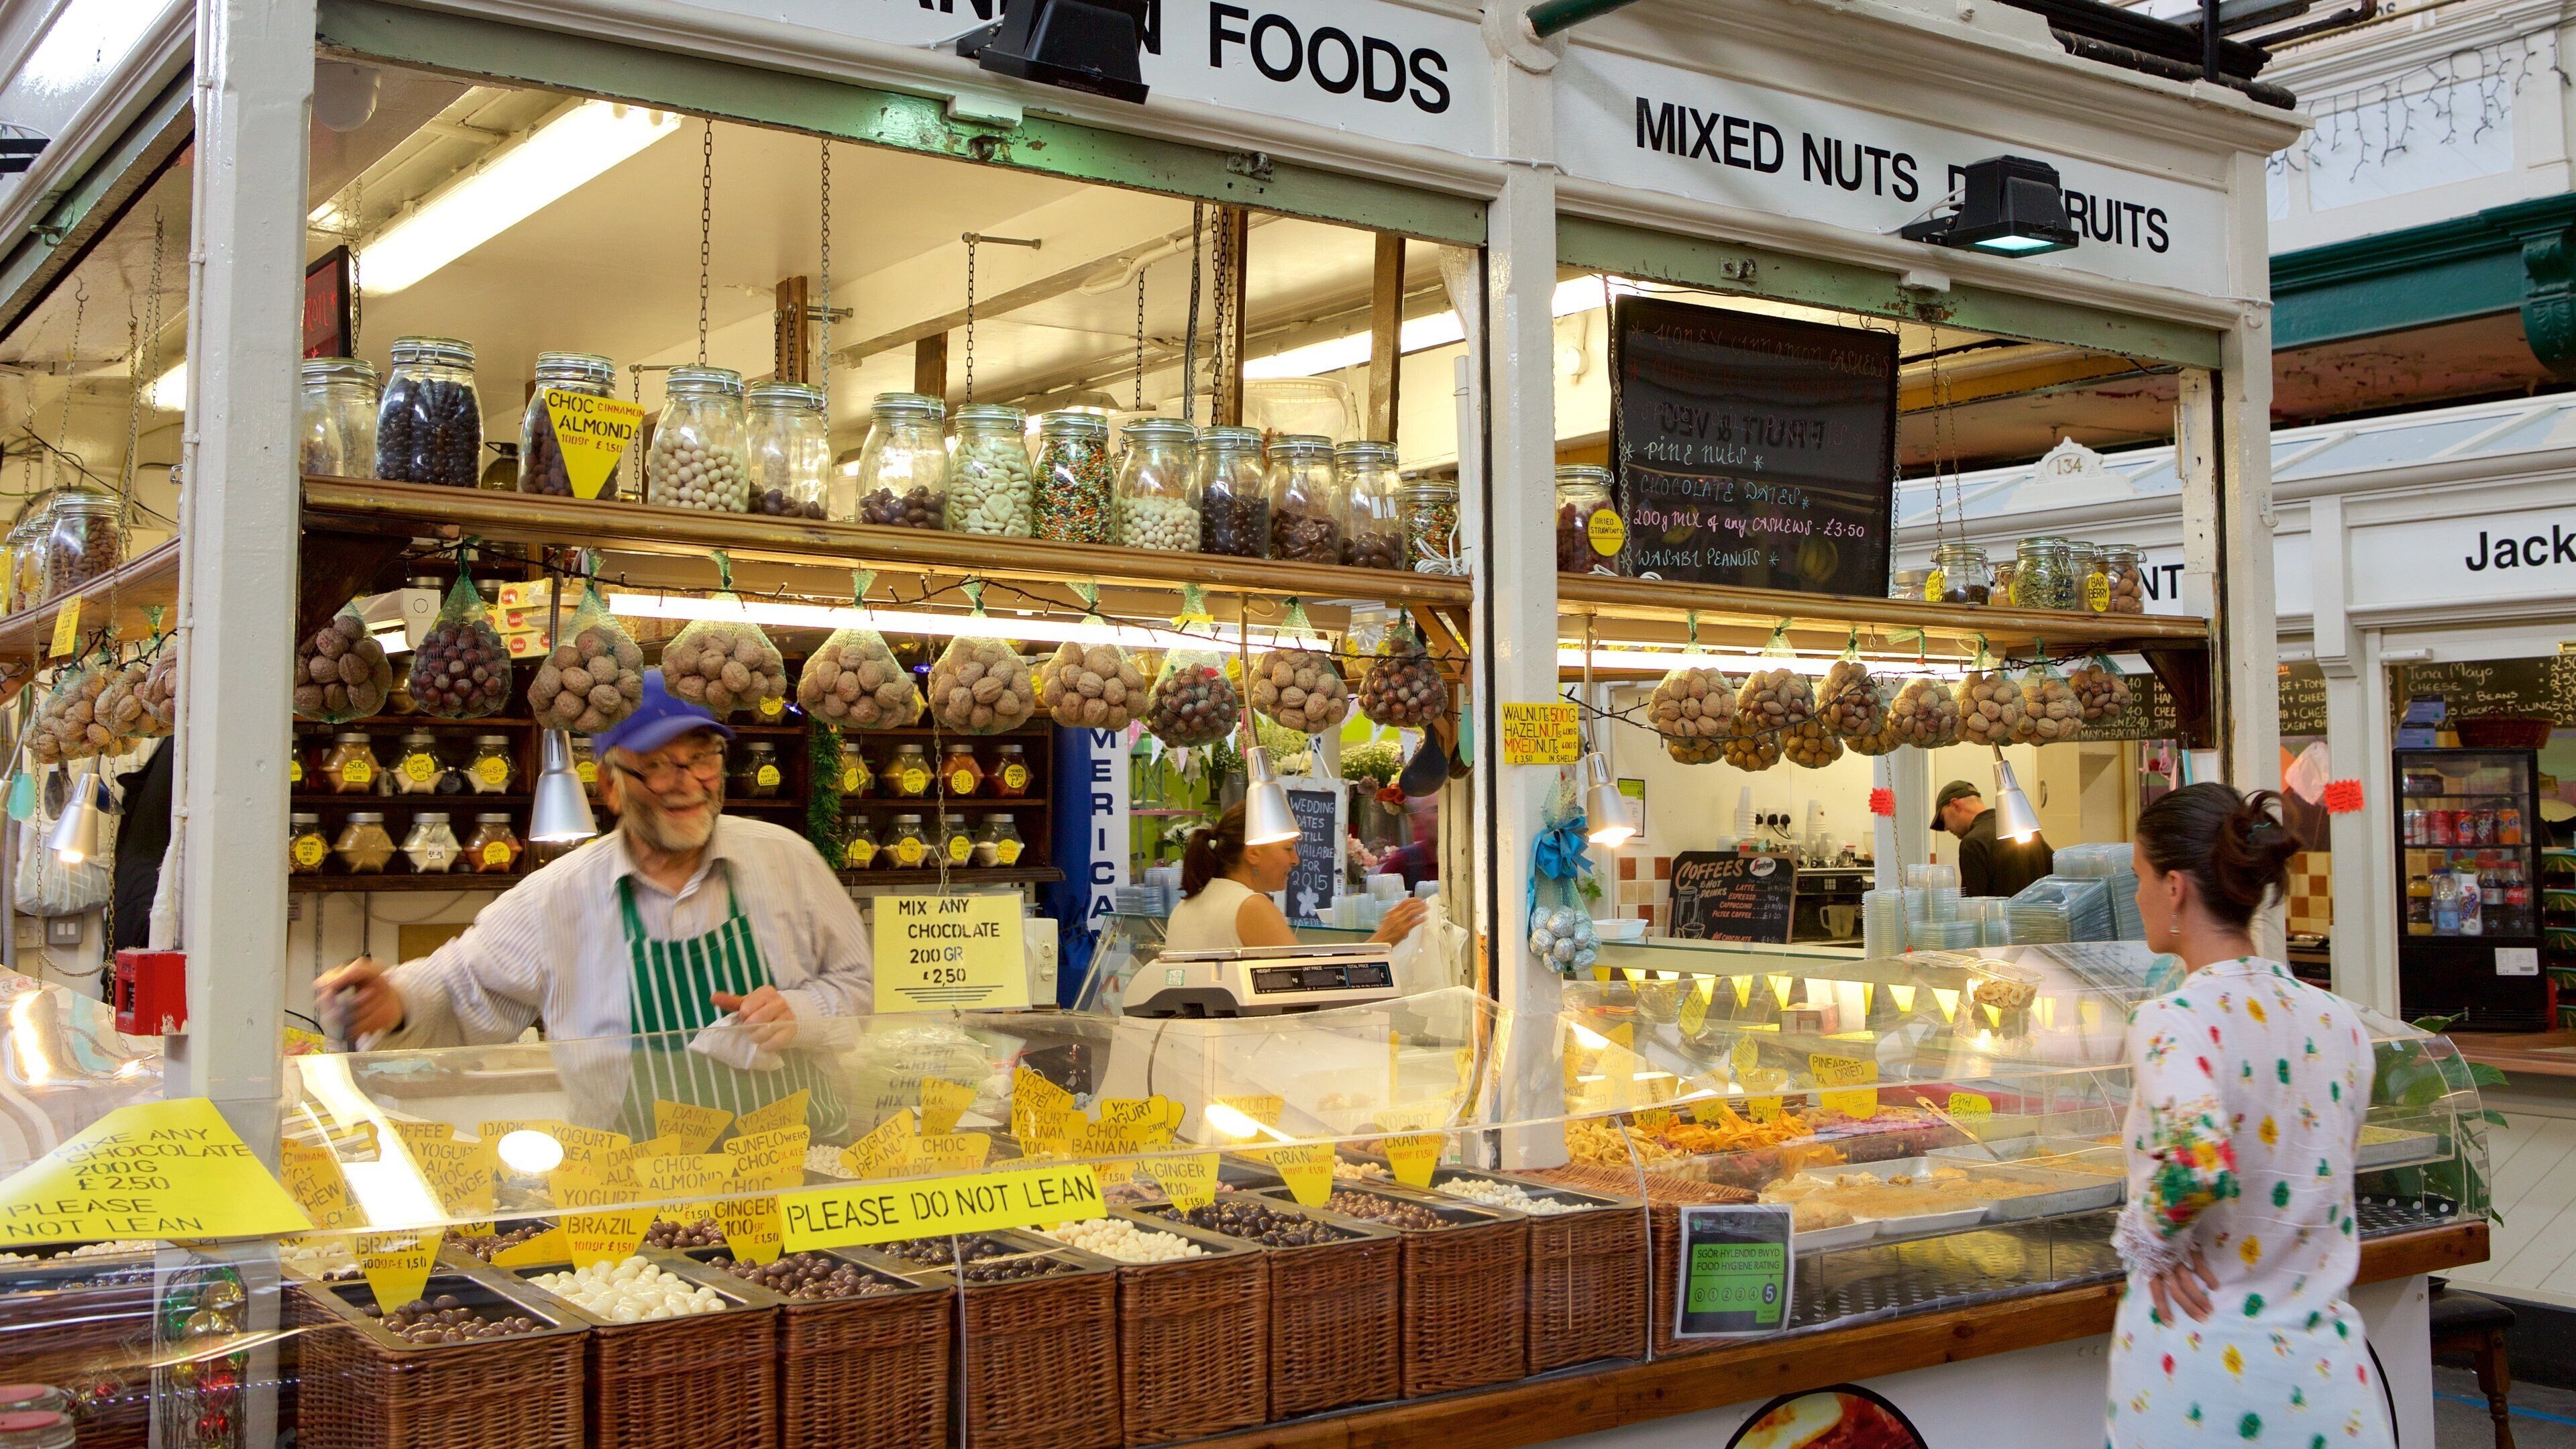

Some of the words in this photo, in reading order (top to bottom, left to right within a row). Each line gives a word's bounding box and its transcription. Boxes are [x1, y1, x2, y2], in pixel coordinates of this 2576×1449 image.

[1209, 3, 1451, 114] FOODS
[1636, 97, 1784, 173] MIXED
[1803, 132, 1918, 203] NUTS
[2059, 189, 2169, 254] RUITS
[549, 392, 594, 414] CHOC
[598, 402, 645, 418] CINNAMON
[559, 415, 632, 440] ALMOND
[561, 433, 589, 446] 100gr
[2057, 456, 2082, 474] 134
[1640, 474, 1733, 503] CHOCOLATE
[1746, 482, 1801, 506] DATES
[1595, 517, 1614, 525] DRIED
[1752, 515, 1813, 536] CASHEWS
[2465, 525, 2576, 571] Jack
[1707, 548, 1760, 568] PEANUTS
[2088, 588, 2107, 598] BERRY
[2477, 690, 2519, 702] BEANS
[411, 763, 430, 774] SALT
[1290, 796, 1335, 814] WEDDING
[1296, 816, 1325, 828] DATES
[1302, 859, 1320, 872] FOR
[1291, 871, 1328, 891] 2015
[1675, 859, 1744, 891] COFFEES
[1701, 888, 1727, 898] DRINKS
[1735, 883, 1756, 892] LATTE
[899, 900, 927, 916] MIX
[938, 899, 969, 914] ANY
[1712, 910, 1729, 918] FILTER
[1731, 910, 1752, 919] COFFEE
[1719, 902, 1753, 910] CAPPUCCINO
[908, 922, 1000, 938] CHOCOLATE
[1835, 1065, 1864, 1080] DRIED
[672, 1106, 714, 1124] DARK
[1014, 1108, 1071, 1124] YOGURT
[150, 1129, 208, 1141] ANY
[551, 1125, 616, 1148] YOGURT
[659, 1119, 716, 1139] RAISINS
[1087, 1123, 1128, 1139] CHOC
[849, 1118, 902, 1161] YOGURT
[922, 1138, 967, 1154] CHOC
[1073, 1138, 1139, 1155] BANANA
[66, 1143, 252, 1163] CHOCOLATE
[738, 1147, 804, 1172] CHOCOLATE
[653, 1156, 703, 1174] CHOC
[1154, 1162, 1206, 1178] GINGER
[7, 1199, 157, 1218] PLEASE
[564, 1189, 640, 1210] YOGURT
[714, 1195, 778, 1218] GINGER
[787, 1196, 899, 1234] PLEASE
[910, 1191, 948, 1220] DO
[955, 1185, 1008, 1218] NOT
[1024, 1175, 1097, 1210] LEAN
[5, 1220, 83, 1237] NOT
[107, 1217, 204, 1233] LEAN
[568, 1216, 637, 1236] BRAZIL
[356, 1235, 426, 1255] BRAZIL
[574, 1241, 605, 1252] 100gr
[1720, 1248, 1756, 1258] HYLENDID
[1758, 1248, 1780, 1257] BWYD
[1697, 1261, 1719, 1271] FOOD
[1721, 1261, 1753, 1271] HYGIENE
[1754, 1260, 1780, 1270] RATING
[1765, 1286, 1774, 1301] 5
